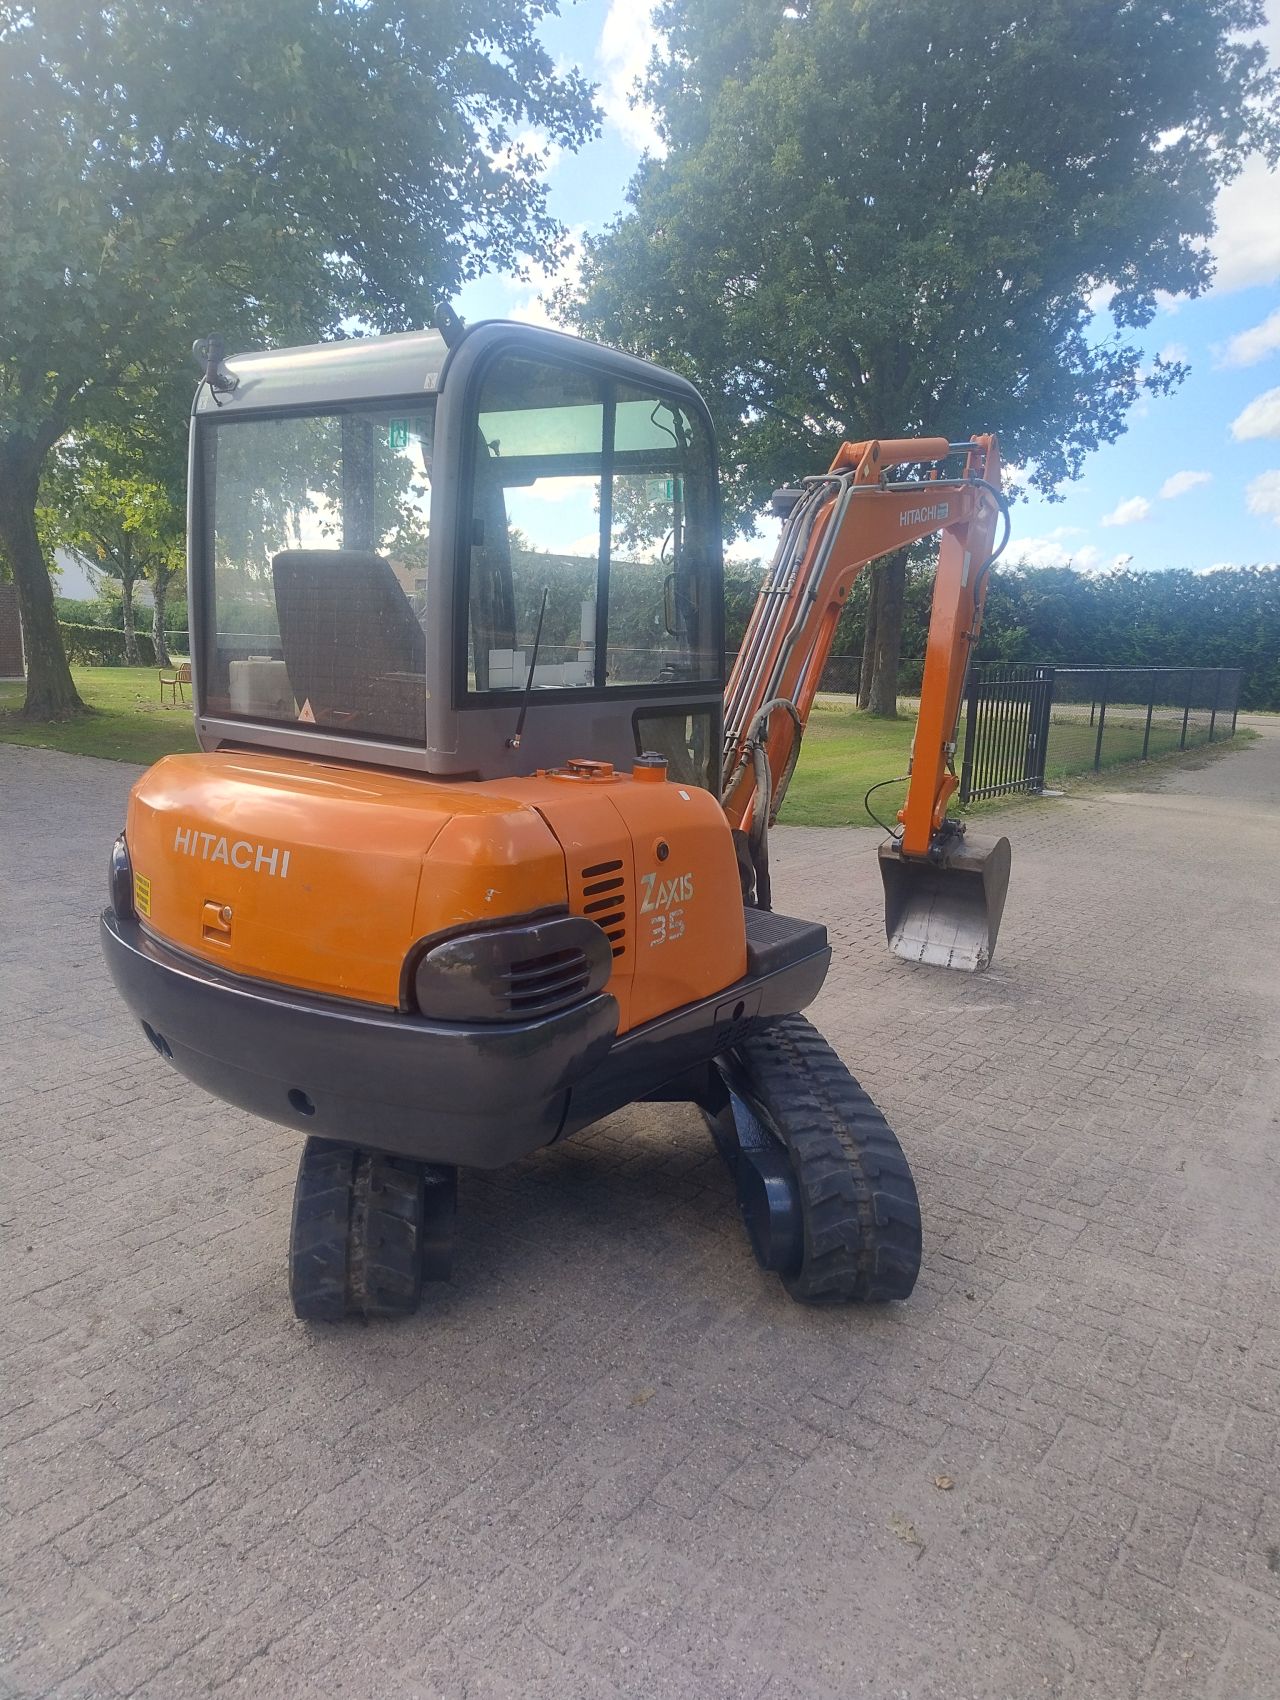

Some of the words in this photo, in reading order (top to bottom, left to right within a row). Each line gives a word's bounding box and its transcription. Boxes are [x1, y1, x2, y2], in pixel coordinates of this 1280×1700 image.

[900, 505, 937, 526] HITACHI
[174, 826, 290, 878] HITACHI
[650, 909, 685, 947] 35
